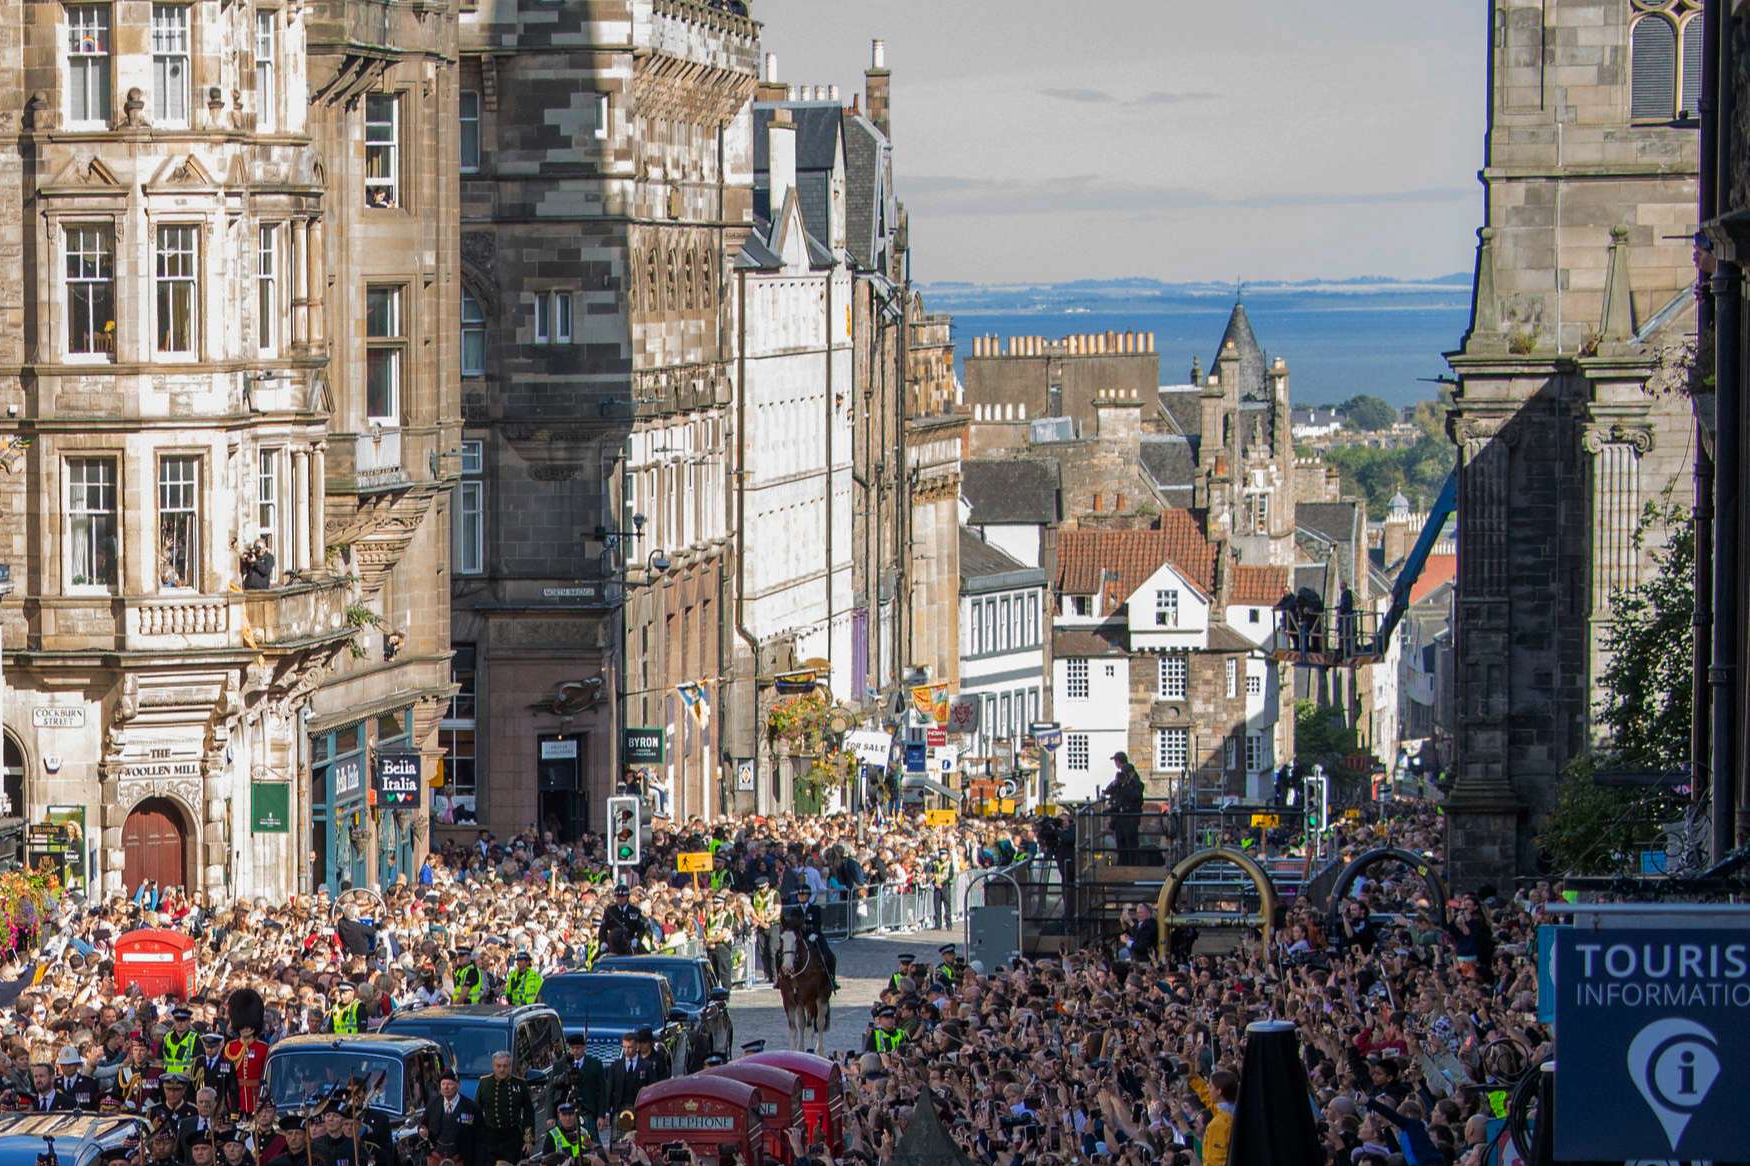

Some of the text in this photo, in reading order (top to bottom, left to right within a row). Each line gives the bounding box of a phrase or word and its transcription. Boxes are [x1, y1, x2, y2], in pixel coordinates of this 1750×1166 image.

[35, 709, 83, 718] COCKBURN
[43, 718, 74, 726] STREET
[628, 736, 659, 748] BYRON
[845, 742, 887, 752] FOR SALE
[150, 748, 171, 759] THE
[124, 764, 198, 777] WOOLLEN MILL
[382, 759, 417, 775] Bella
[381, 776, 418, 791] Italia
[654, 1116, 730, 1129] TELEPHONE
